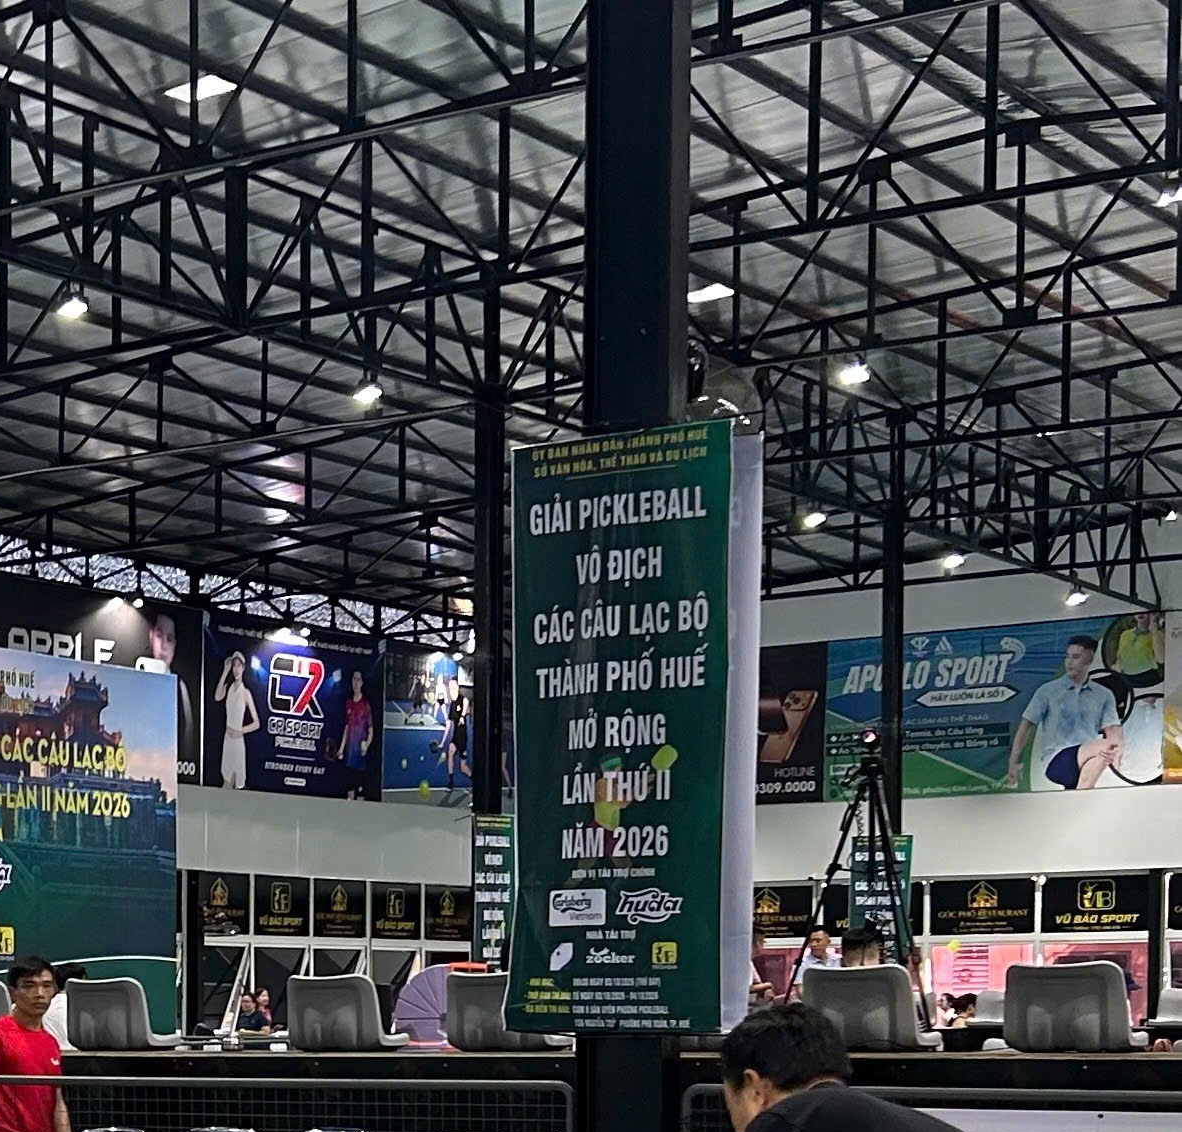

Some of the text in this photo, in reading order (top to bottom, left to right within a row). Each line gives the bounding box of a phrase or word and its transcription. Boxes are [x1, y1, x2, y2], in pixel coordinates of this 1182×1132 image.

[529, 485, 707, 536] GIẢI PICKLEBALL
[575, 544, 663, 588] VÔ ĐỊCH
[533, 590, 709, 645] CÁC CÂU LẠC BỘ
[535, 642, 709, 699] THÀNH PHỐ HUẾ
[934, 652, 1014, 687] SPORT
[1, 728, 34, 763] CÁC
[37, 732, 70, 767] CÂU
[568, 707, 666, 754] MỞ RỘNG
[562, 762, 671, 805] LẦN THỨ II
[774, 765, 817, 778] HOTLINE
[41, 785, 51, 812] II
[54, 784, 89, 815] NĂM
[92, 790, 131, 818] 2026
[562, 821, 669, 860] NĂM 2026
[617, 889, 682, 924] huda
[1099, 913, 1141, 924] SPORT
